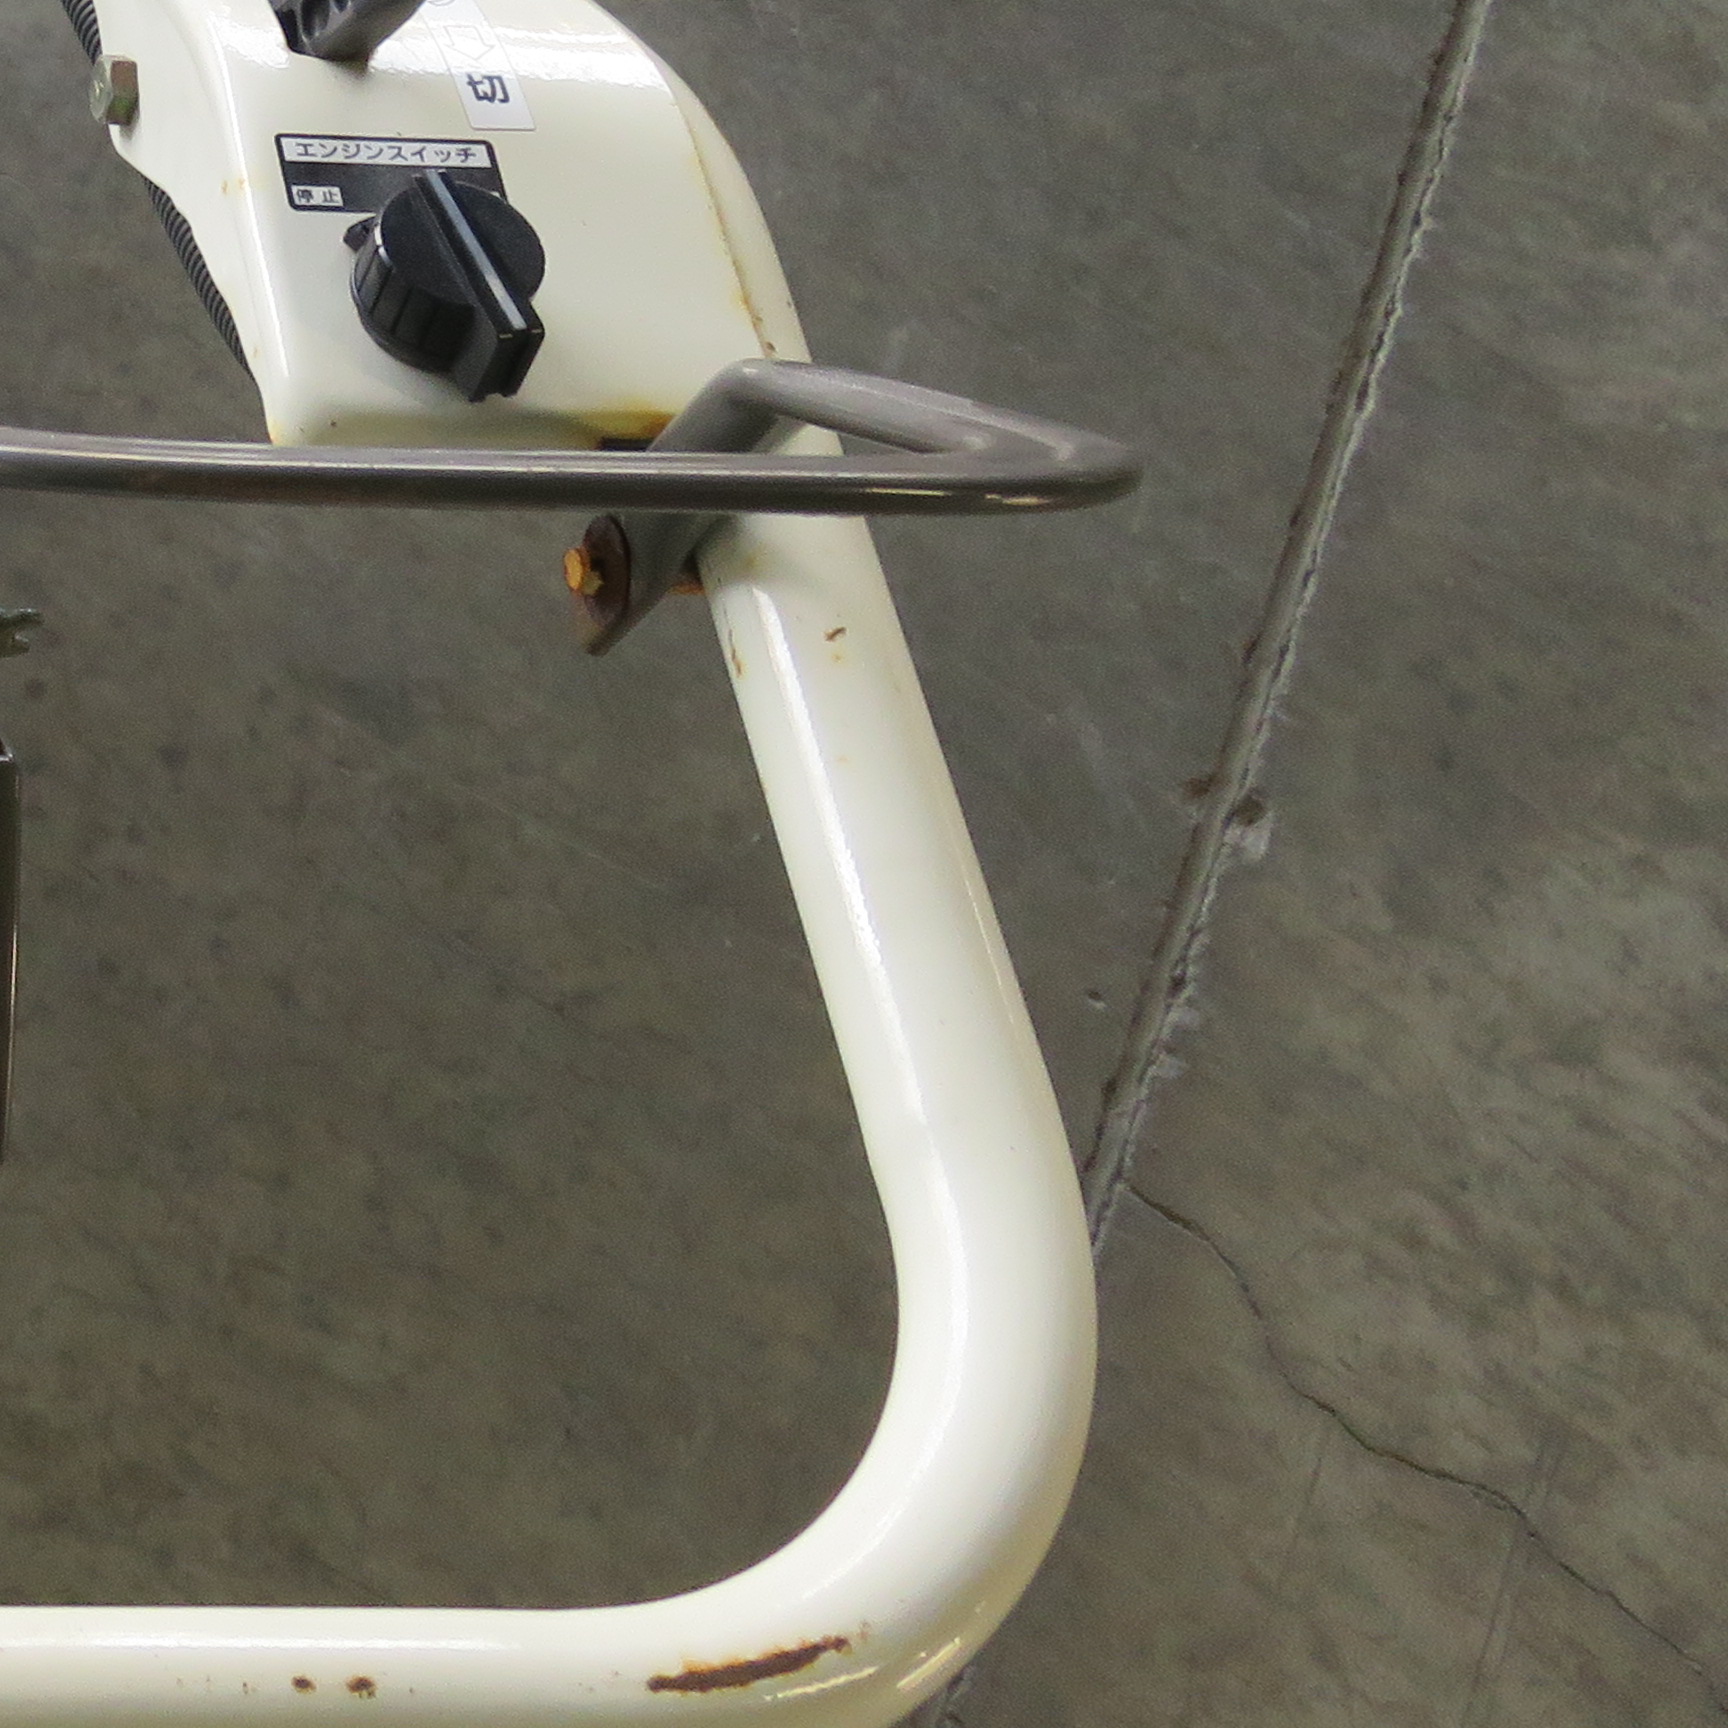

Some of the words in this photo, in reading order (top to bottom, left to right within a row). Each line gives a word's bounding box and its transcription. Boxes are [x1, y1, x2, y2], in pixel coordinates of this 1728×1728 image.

[466, 73, 510, 104] 切
[295, 141, 477, 164] エンジンスイッチ
[296, 188, 342, 205] 停止
